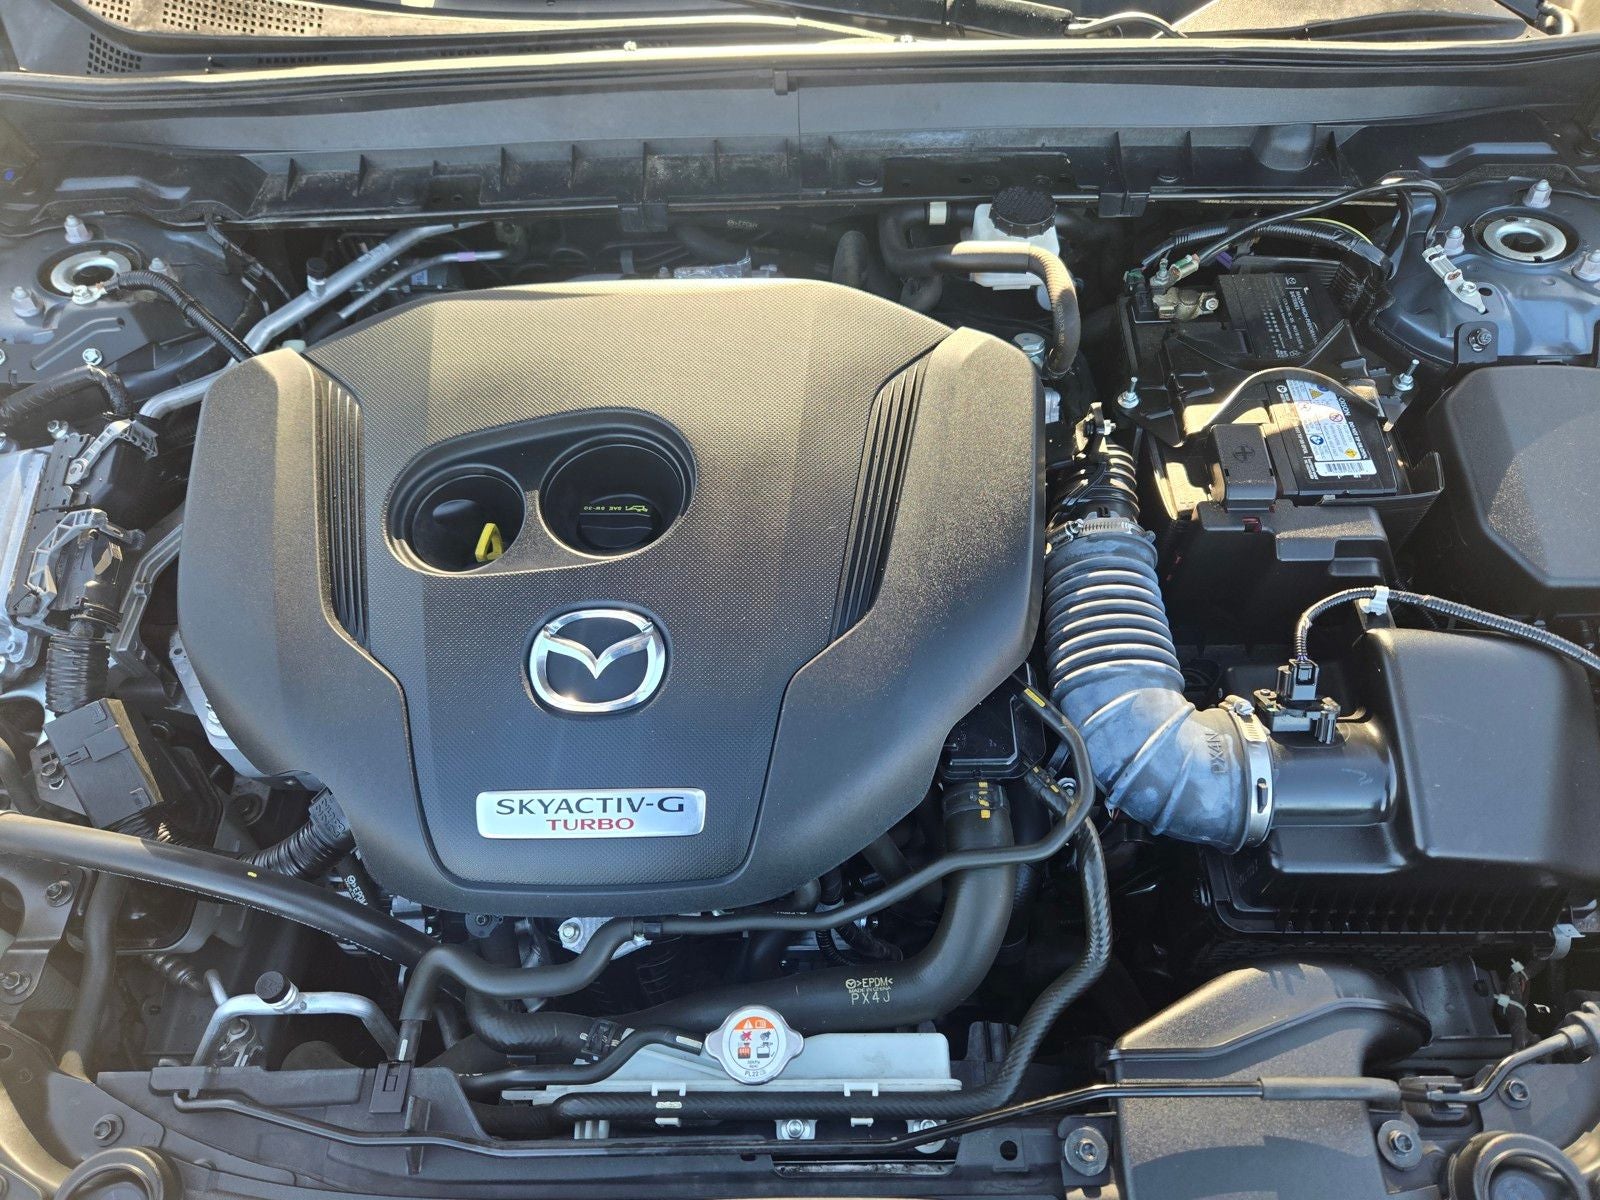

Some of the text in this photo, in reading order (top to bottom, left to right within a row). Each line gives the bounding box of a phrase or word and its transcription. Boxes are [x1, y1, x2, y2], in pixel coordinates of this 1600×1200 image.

[496, 796, 684, 815] SKYACTIV-G
[546, 817, 634, 831] TURBO
[851, 991, 890, 1005] PX4J
